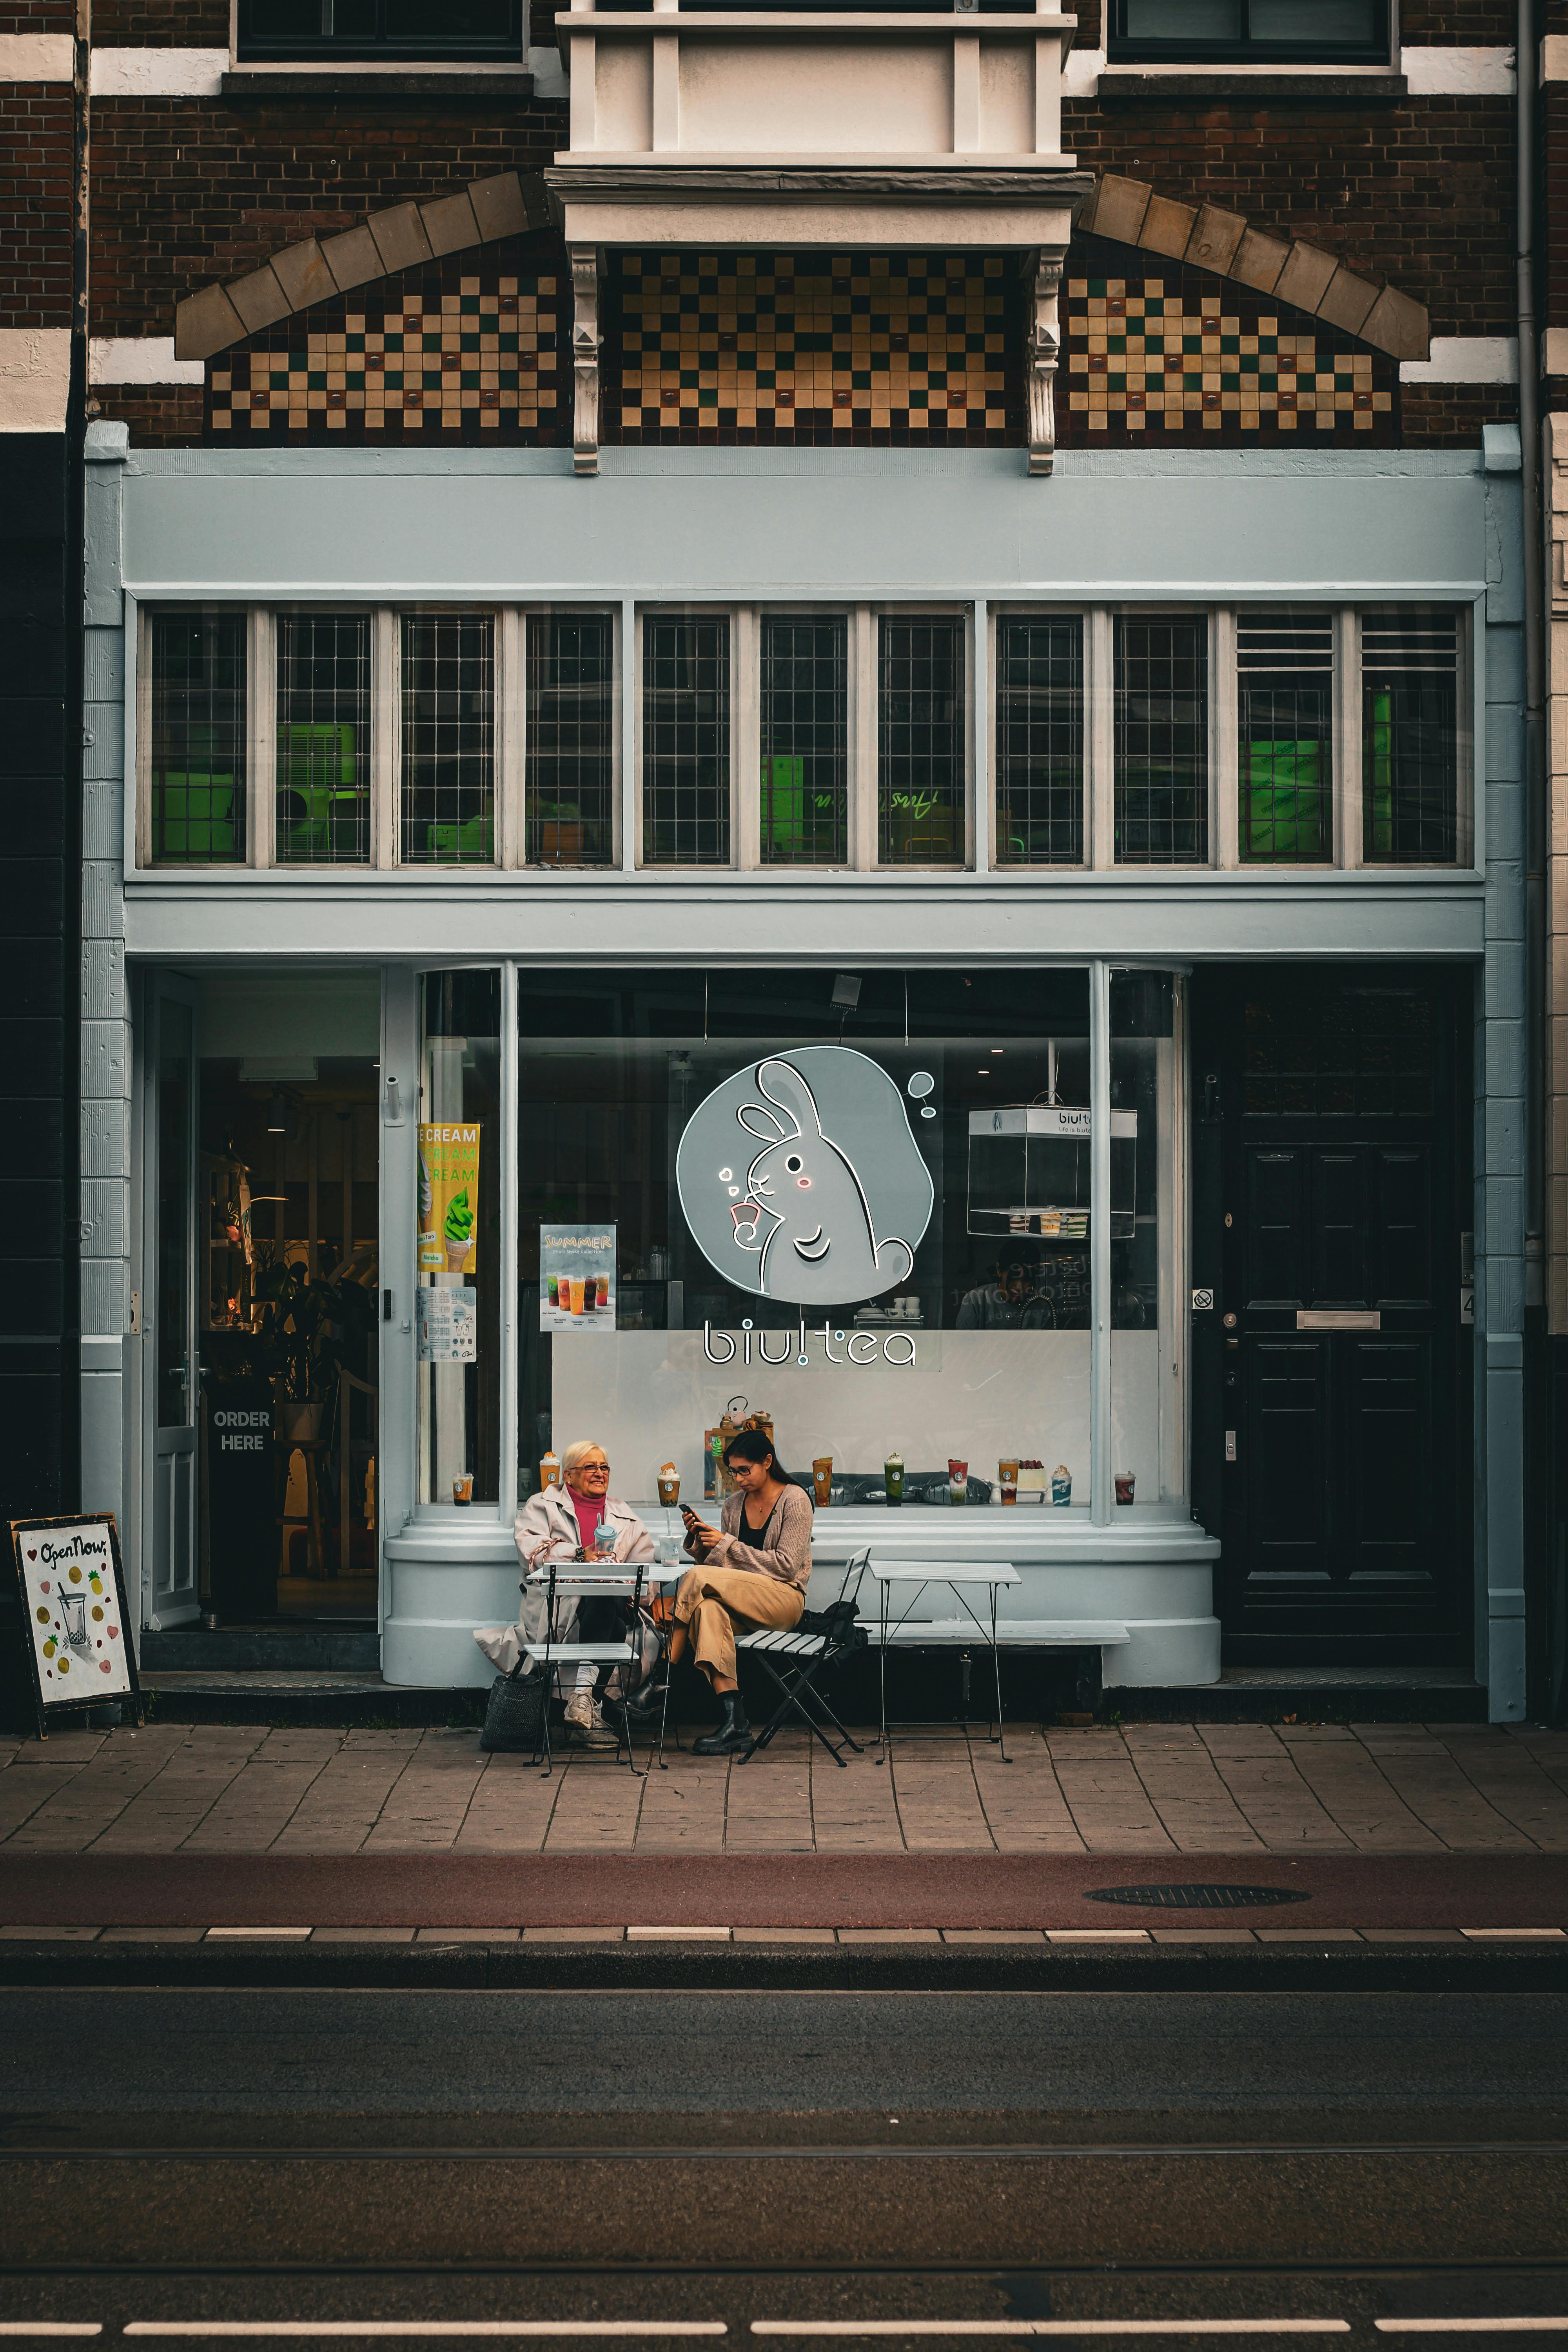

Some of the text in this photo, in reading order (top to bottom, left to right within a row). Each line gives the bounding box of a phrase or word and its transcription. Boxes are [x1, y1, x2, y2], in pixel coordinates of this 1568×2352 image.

[1059, 1112, 1091, 1124] biu!t
[426, 1129, 476, 1142] CREAM
[426, 1148, 475, 1161] CREAM
[544, 1235, 612, 1249] SUMMER
[703, 1318, 916, 1367] biu!tea
[214, 1412, 270, 1426] ORDER
[221, 1435, 263, 1450] HERE
